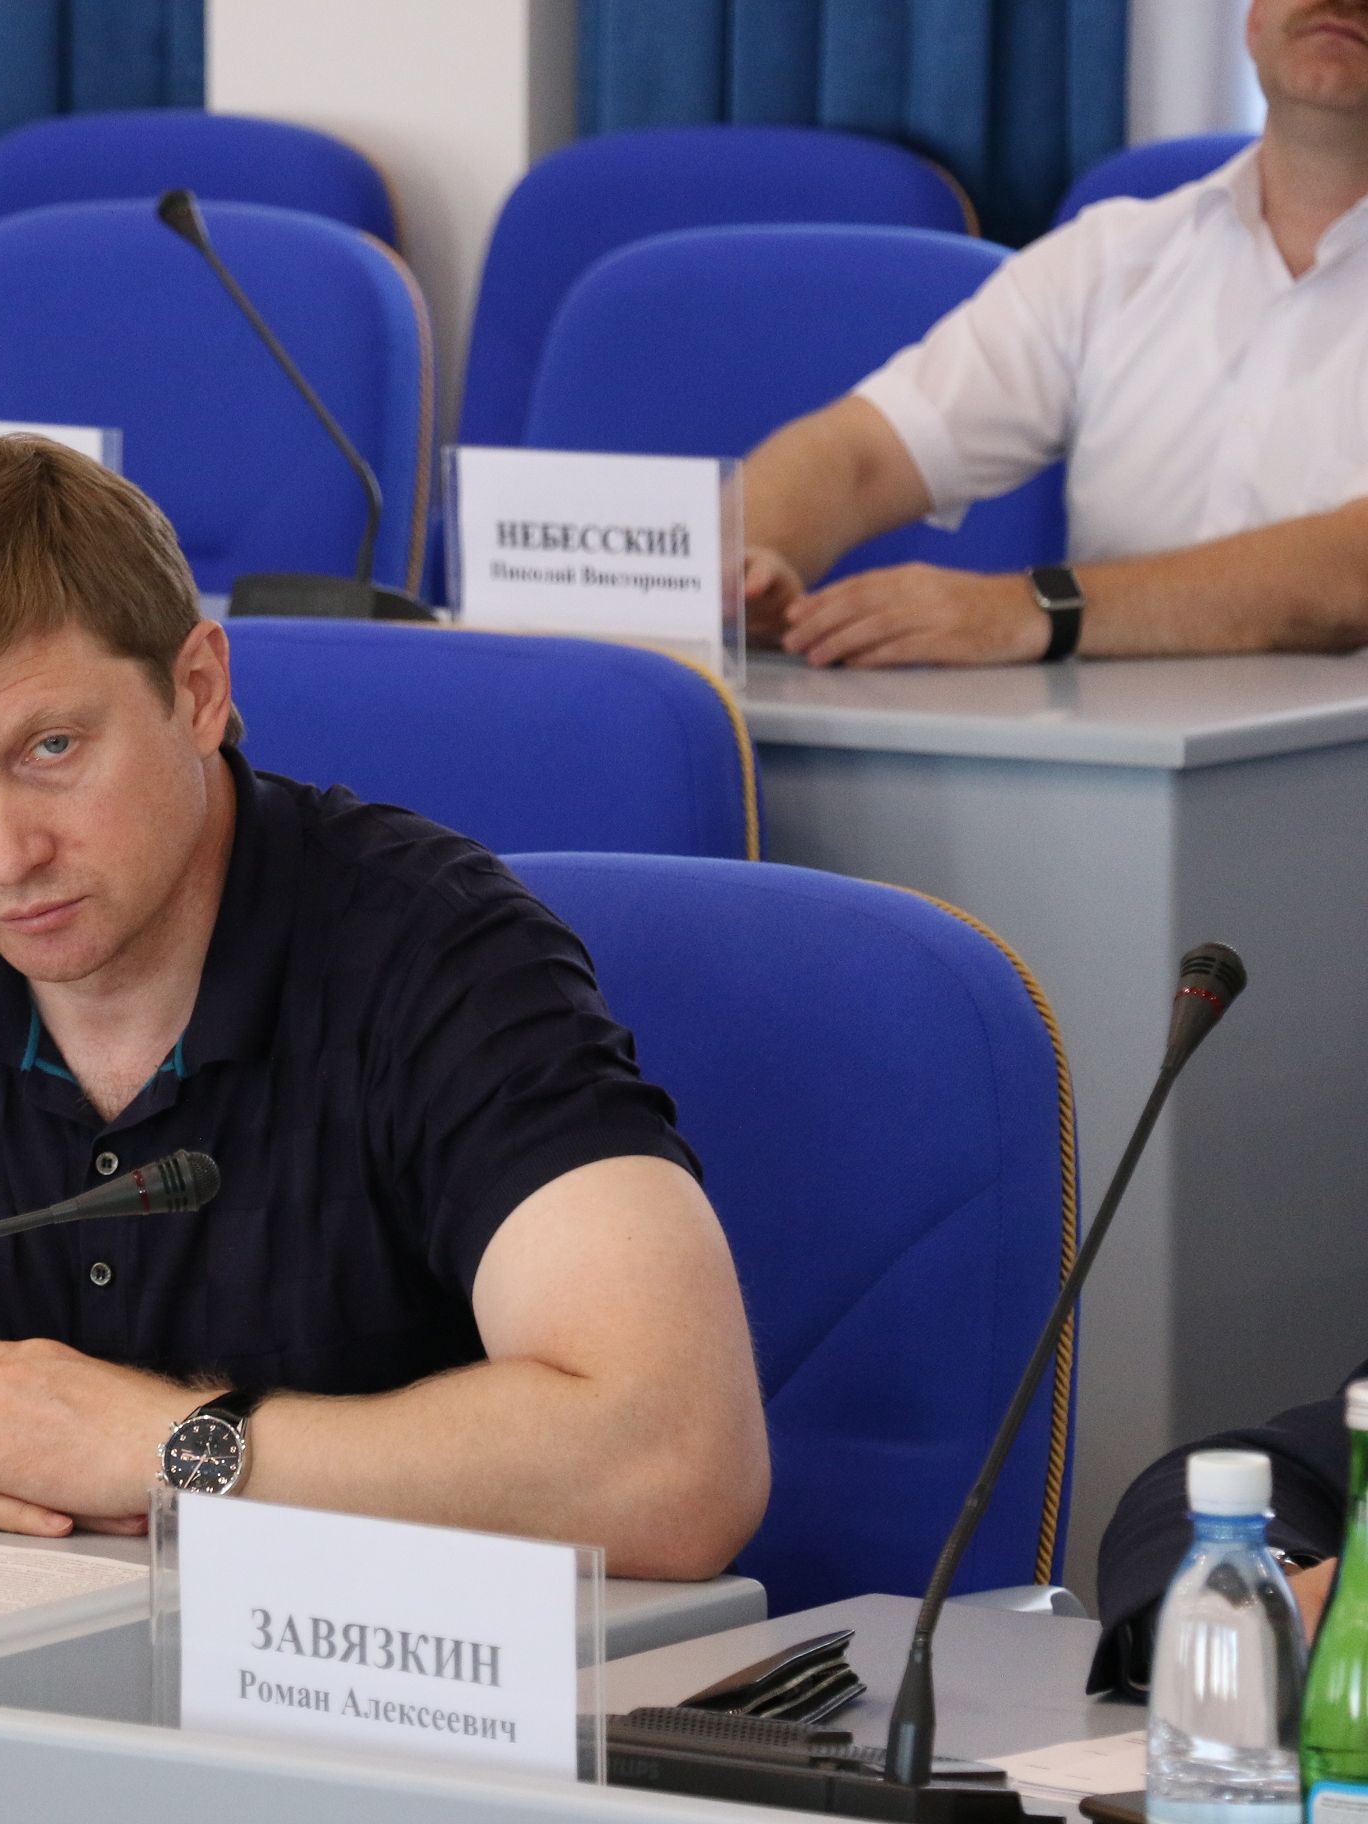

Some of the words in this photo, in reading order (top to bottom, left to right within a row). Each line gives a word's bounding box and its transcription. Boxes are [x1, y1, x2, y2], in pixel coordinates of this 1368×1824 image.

[496, 521, 691, 556] НЕБЕССКИЙ
[490, 560, 576, 585] Николай
[581, 564, 702, 592] Викторович
[250, 1607, 502, 1688] ЗАВЯЗКИН
[238, 1669, 331, 1713] Роман
[341, 1688, 517, 1743] Алексеевич
